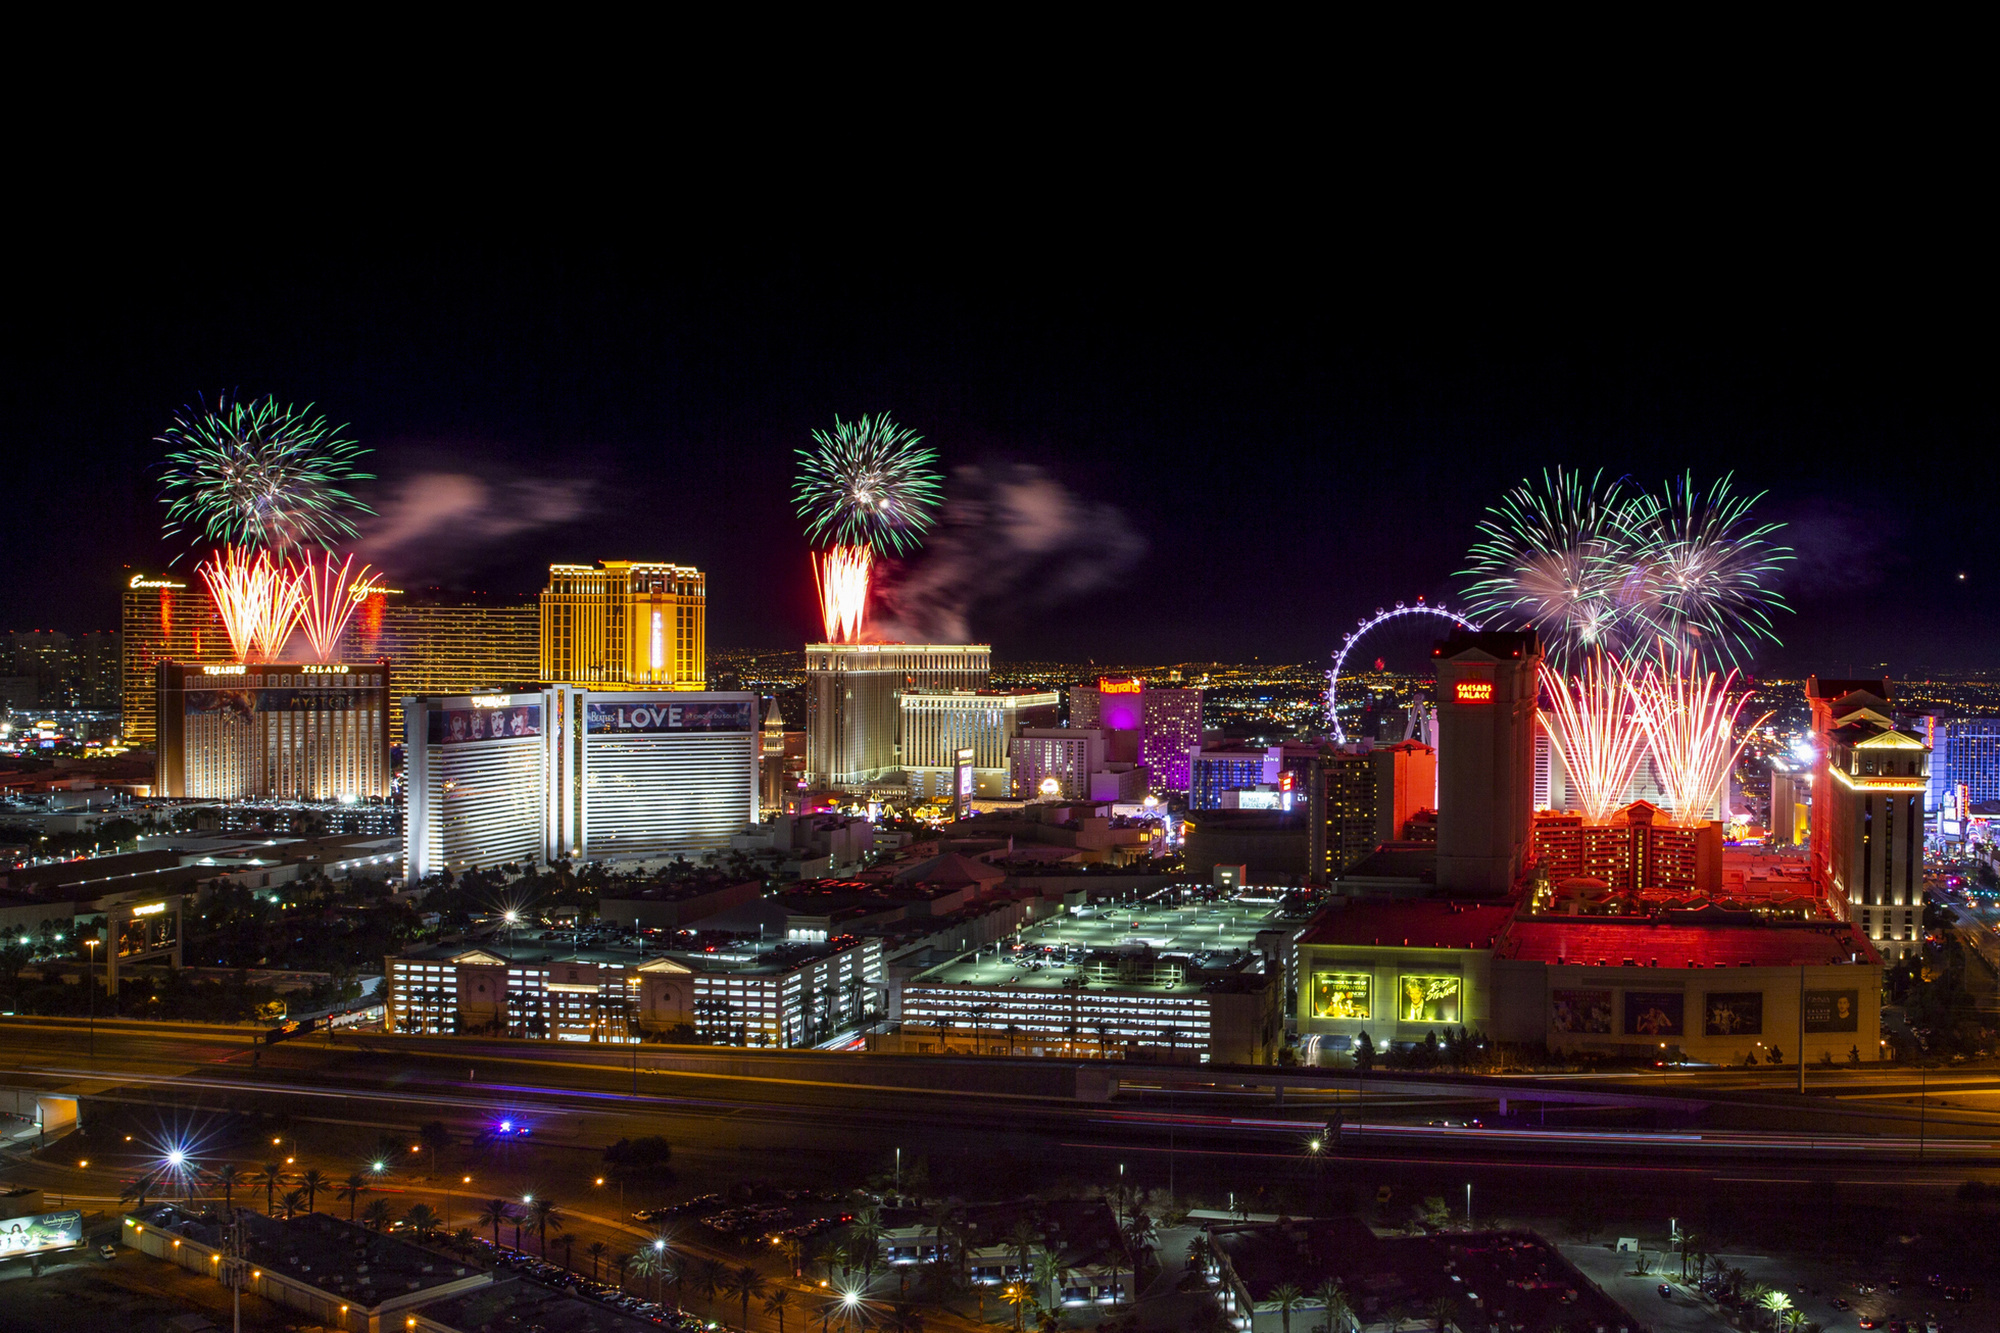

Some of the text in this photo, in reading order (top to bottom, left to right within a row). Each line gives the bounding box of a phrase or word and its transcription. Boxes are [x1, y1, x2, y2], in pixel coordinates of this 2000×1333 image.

[130, 574, 187, 588] Encore
[203, 665, 349, 675] TREASURE ISLAND
[1456, 683, 1492, 692] CAESARS
[1458, 691, 1490, 699] PALACE
[618, 708, 683, 728] LOVE
